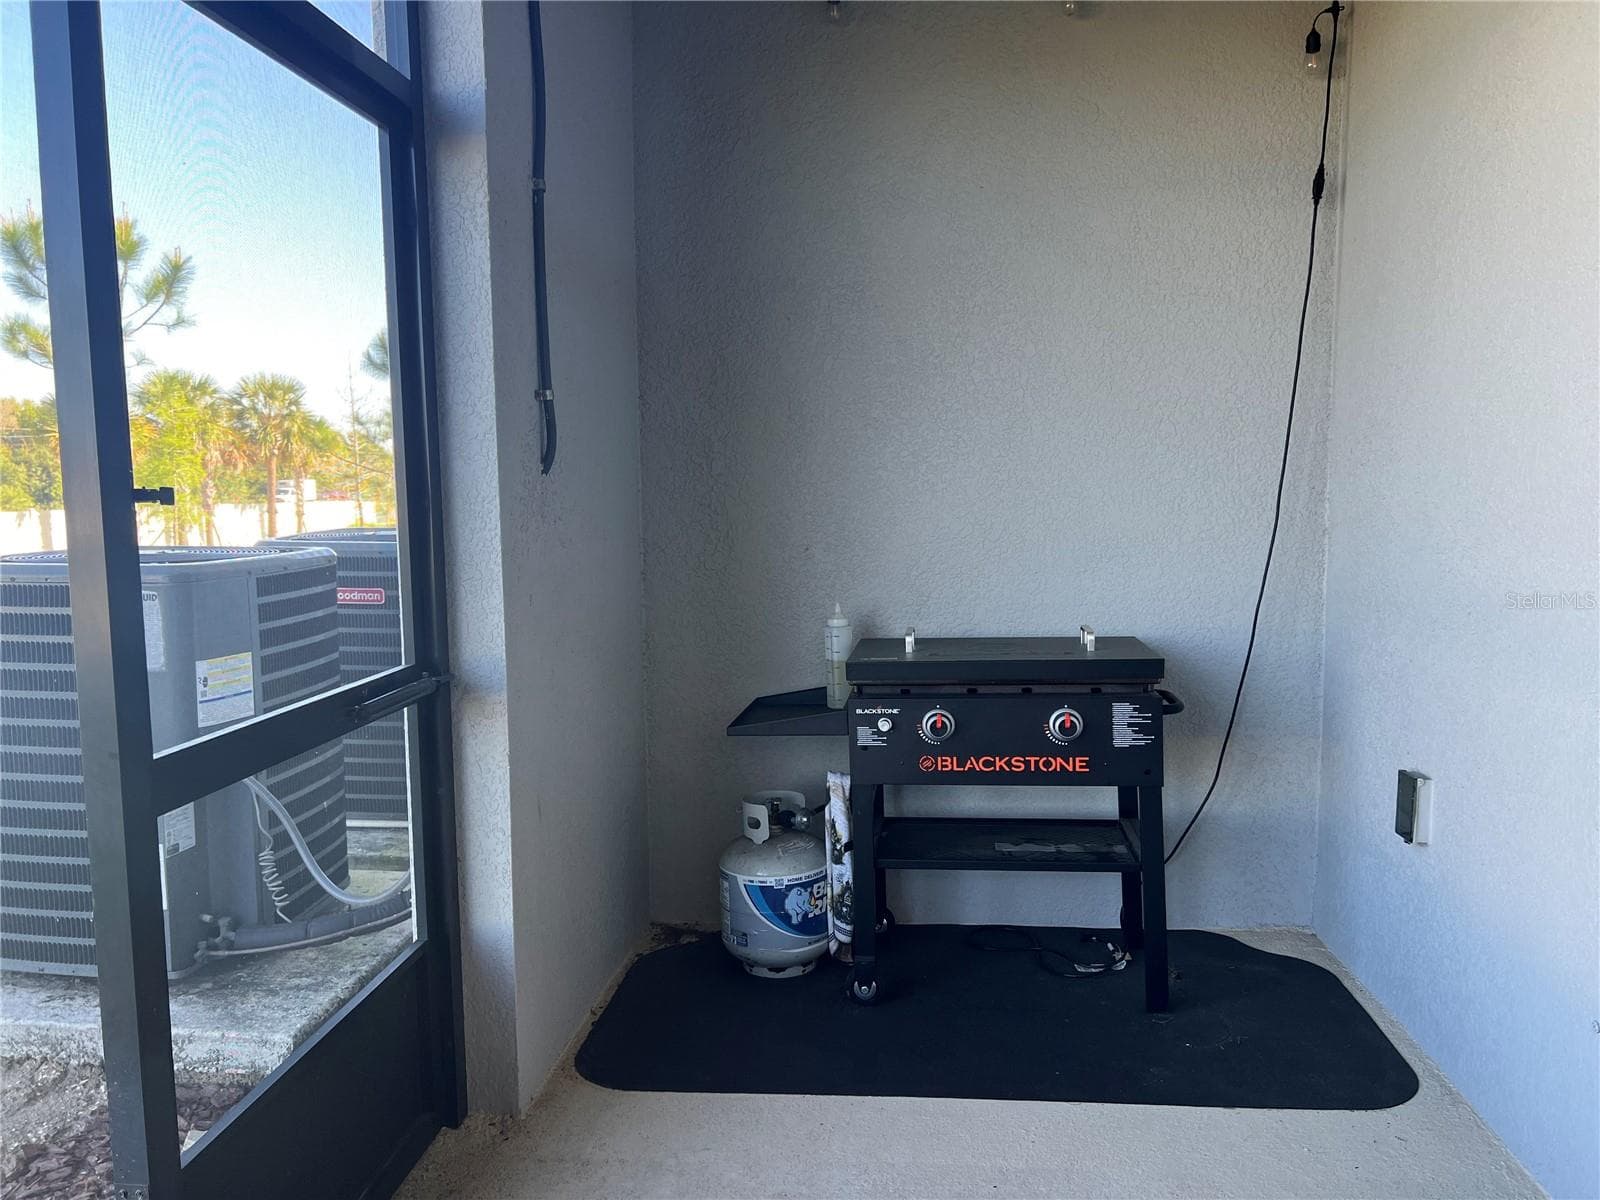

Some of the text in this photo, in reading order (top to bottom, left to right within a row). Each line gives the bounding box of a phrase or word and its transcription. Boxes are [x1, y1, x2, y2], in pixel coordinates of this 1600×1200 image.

[142, 593, 158, 601] UID
[337, 592, 381, 600] oodman
[937, 756, 1090, 772] BLACKSTONE
